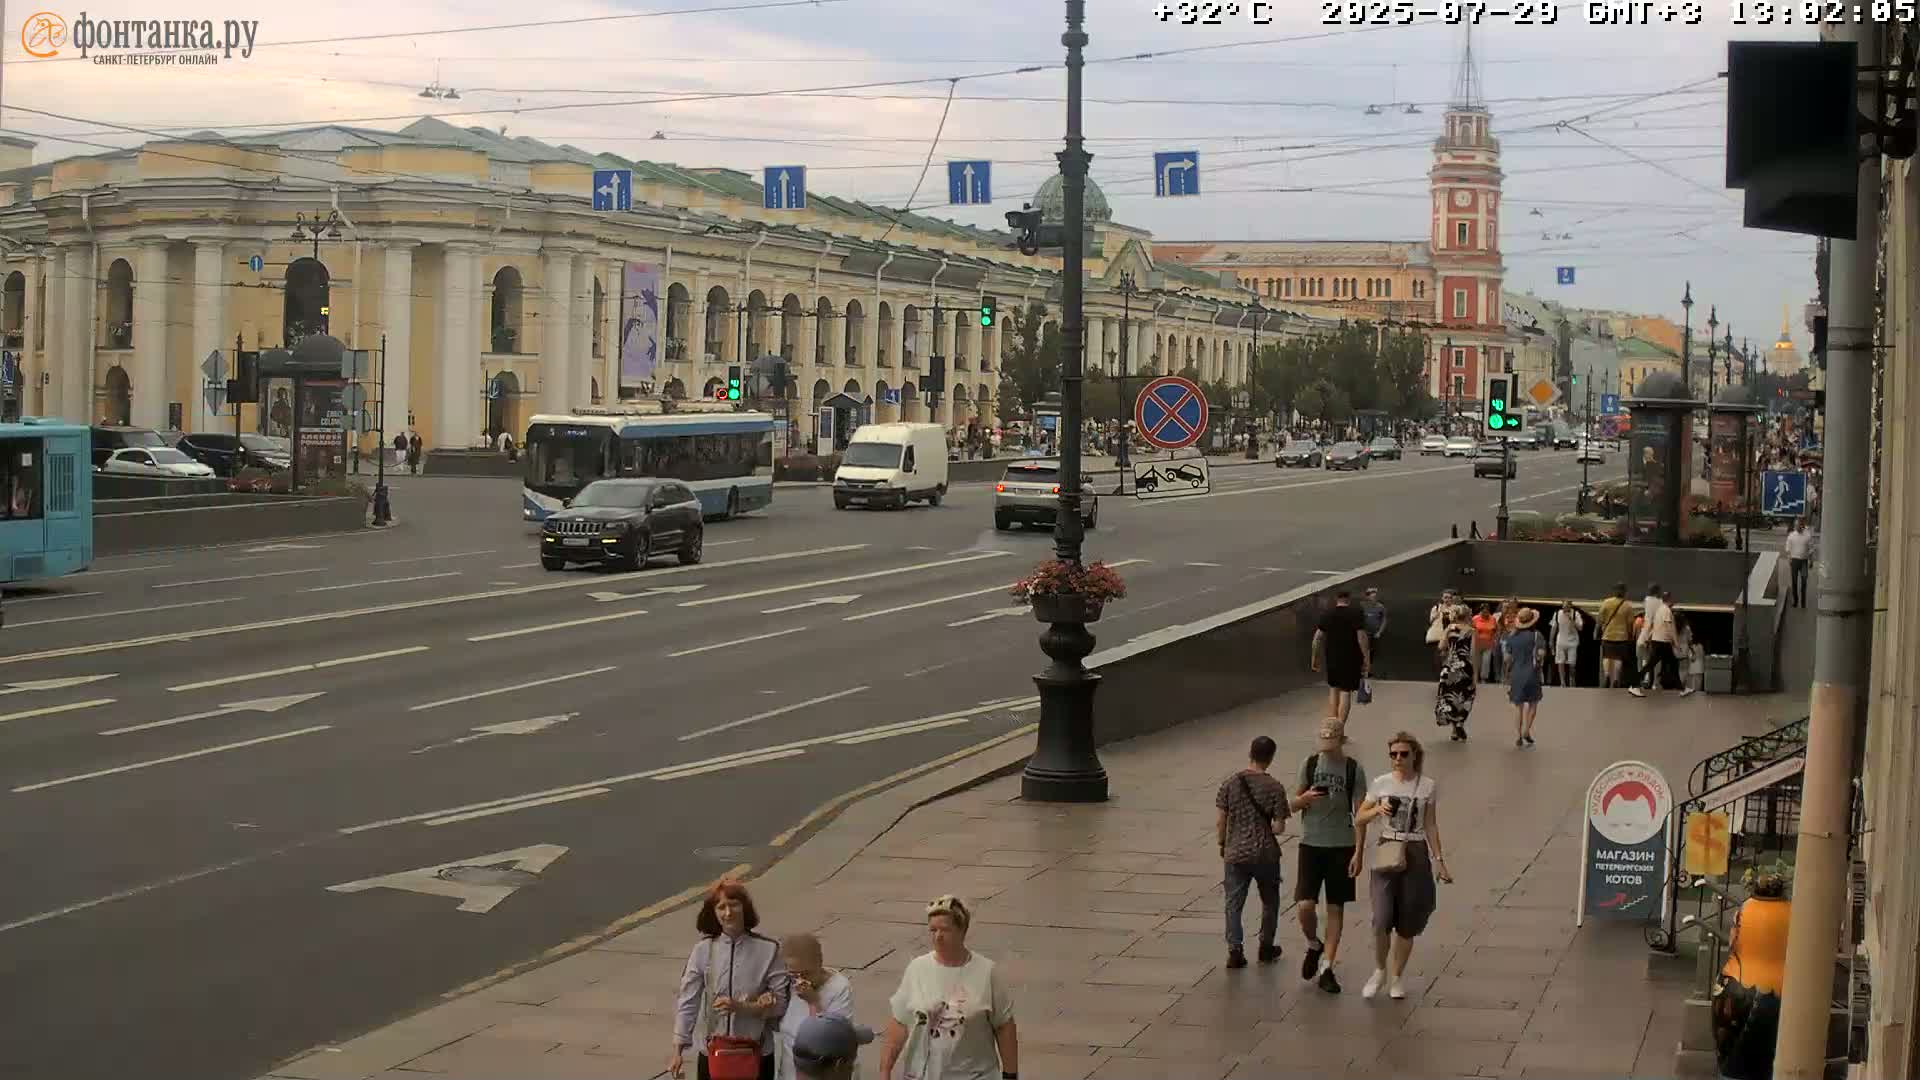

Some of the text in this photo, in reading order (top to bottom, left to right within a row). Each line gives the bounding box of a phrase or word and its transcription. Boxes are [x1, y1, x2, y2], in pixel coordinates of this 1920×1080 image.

[1491, 399, 1504, 412] 40
[1596, 848, 1655, 862] МАГАЗИН
[1605, 874, 1642, 885] КОТОВ
